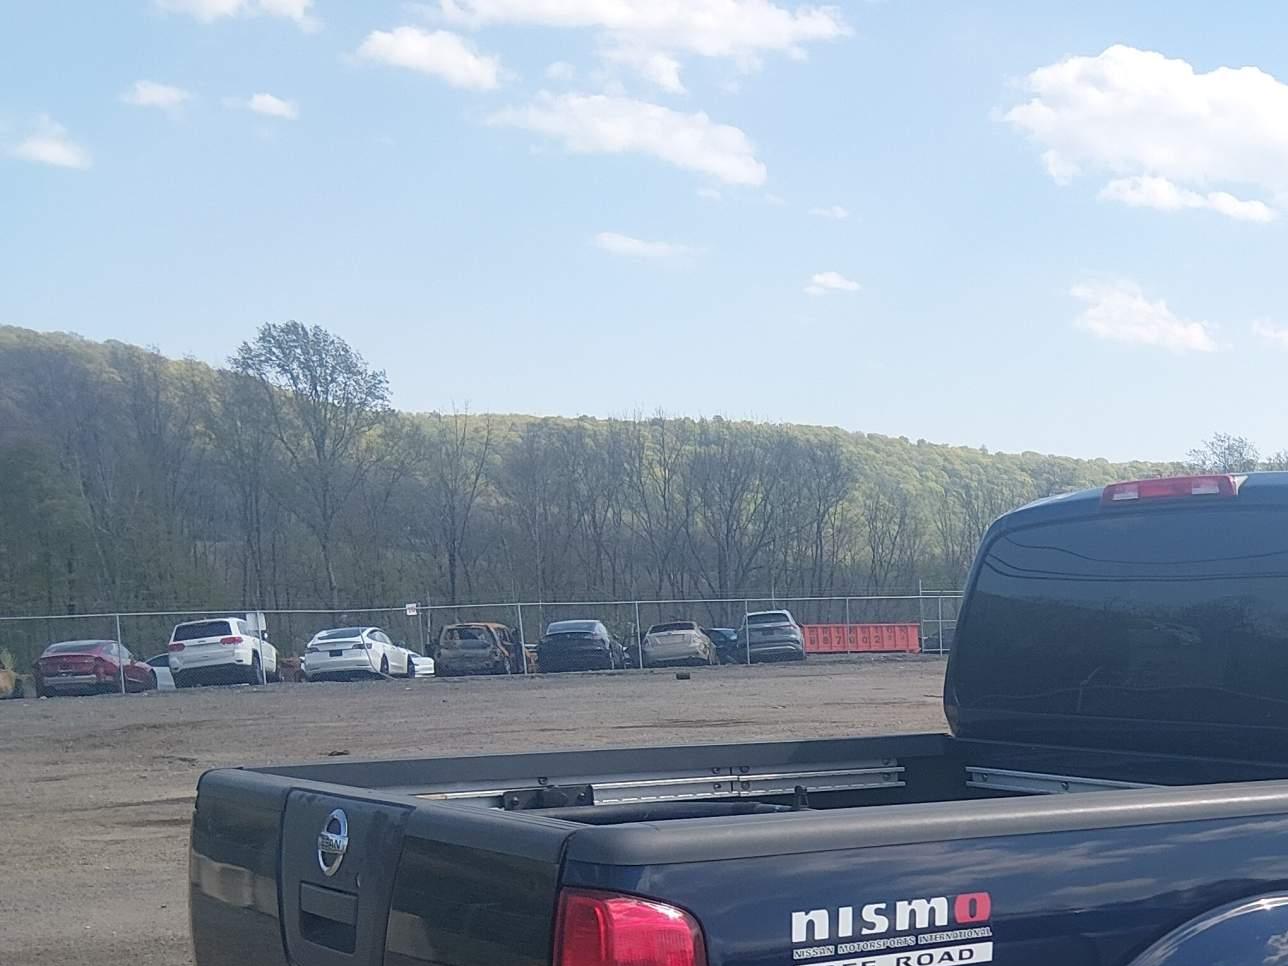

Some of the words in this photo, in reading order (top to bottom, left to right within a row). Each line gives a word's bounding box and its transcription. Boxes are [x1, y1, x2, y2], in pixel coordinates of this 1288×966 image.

[793, 945, 835, 959] NISSAN
[838, 935, 917, 954] MOTORSPORTS
[918, 927, 992, 944] INTERNATIONAL
